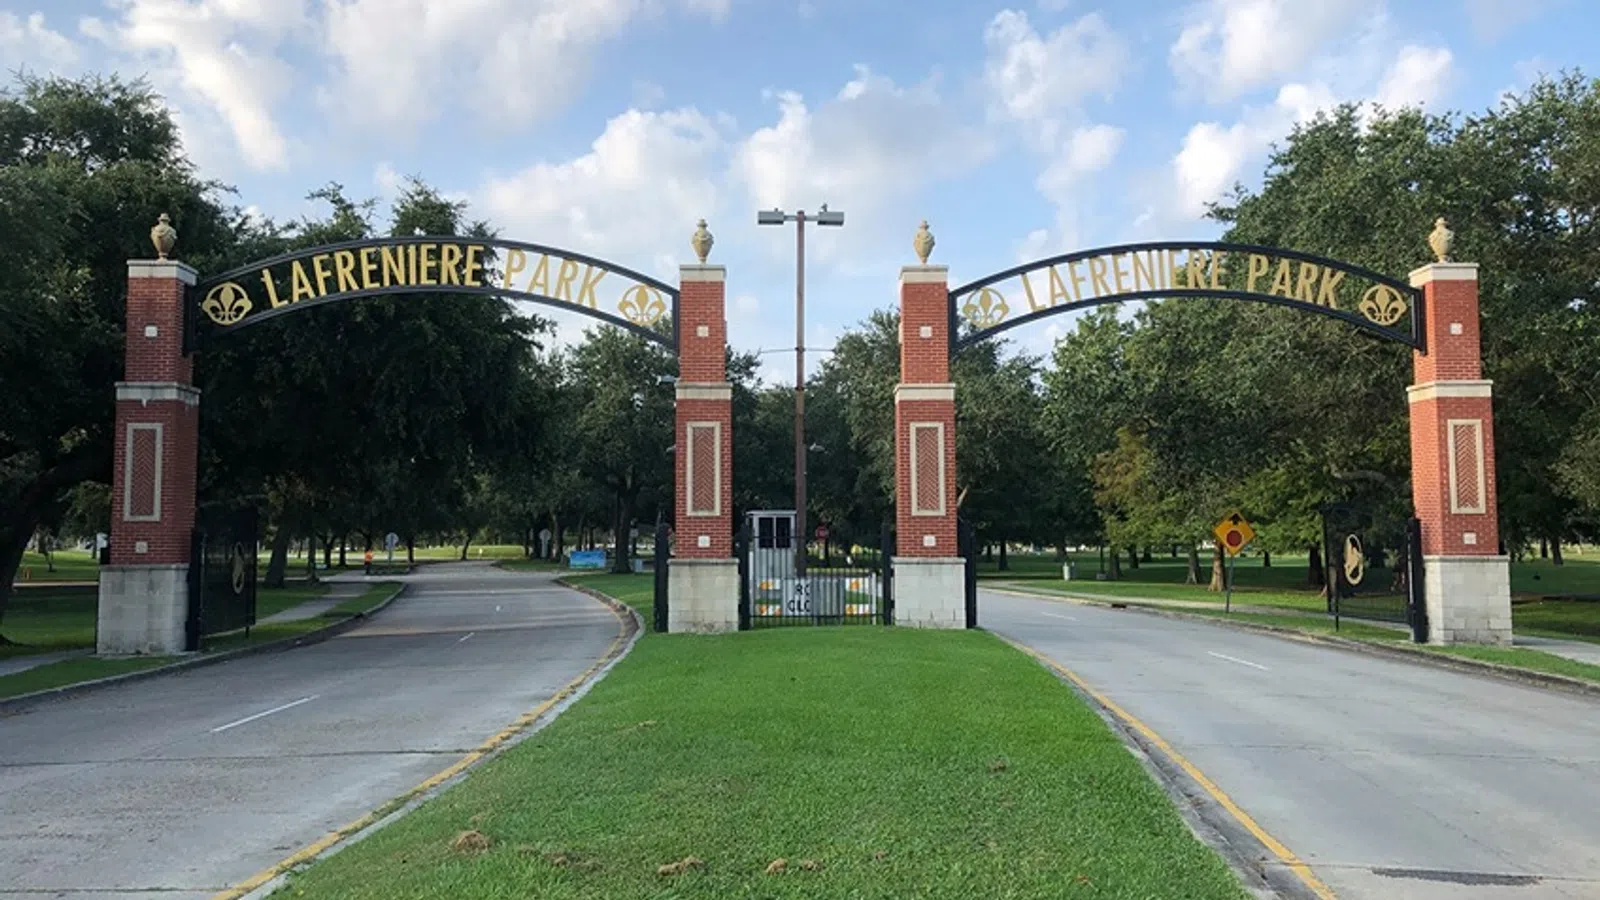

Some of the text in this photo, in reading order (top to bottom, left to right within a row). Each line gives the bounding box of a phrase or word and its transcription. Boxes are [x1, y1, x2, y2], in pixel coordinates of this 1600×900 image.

[261, 243, 609, 309] LAFRENIERE PARK
[1020, 249, 1347, 313] LAFRENIERE PARK
